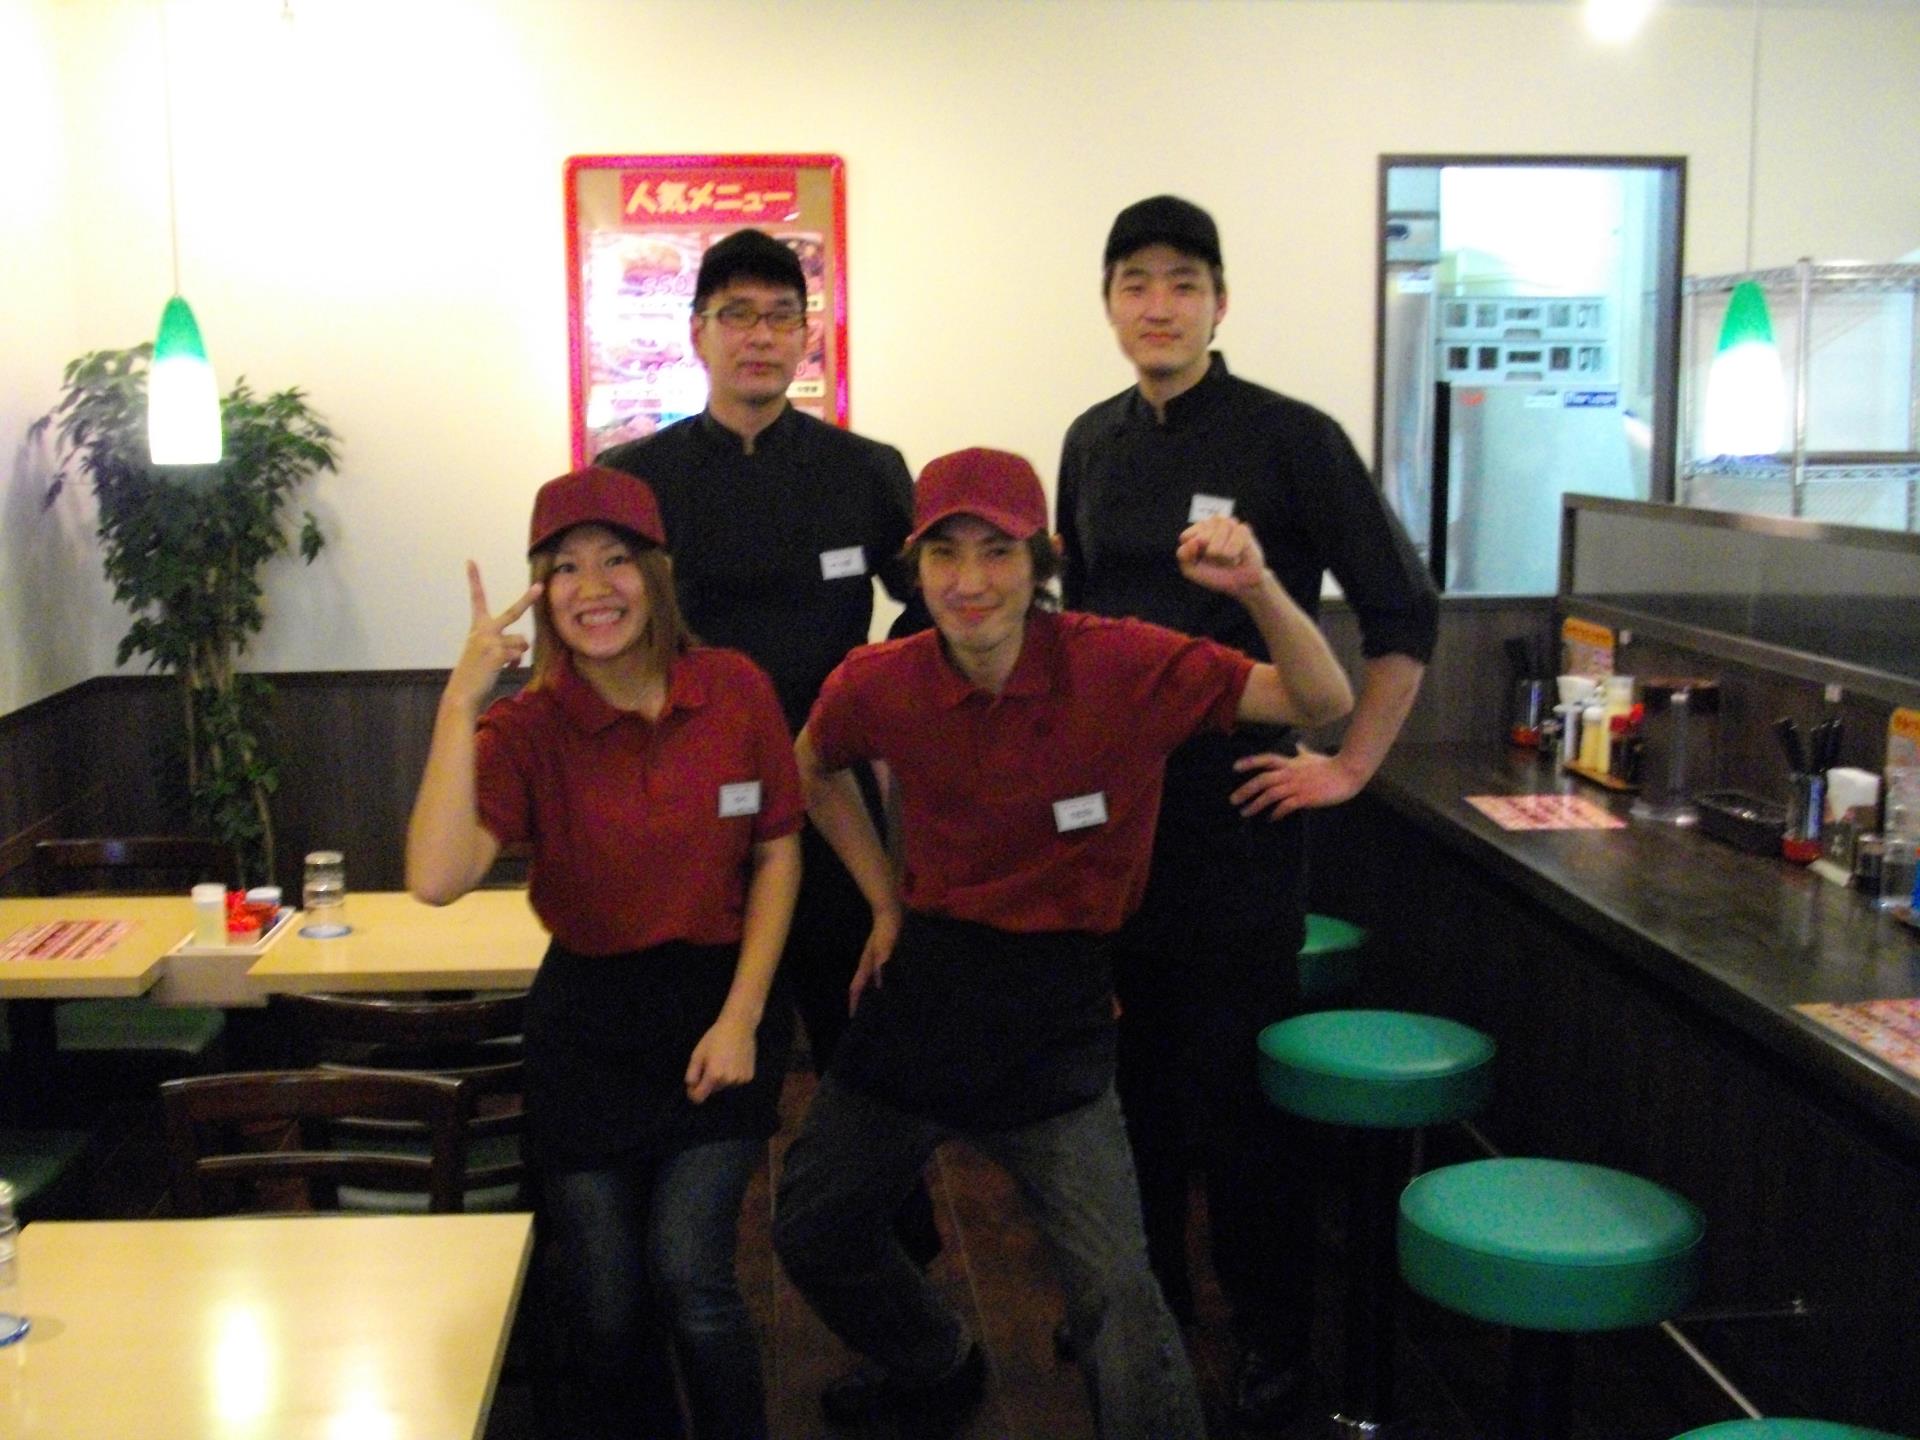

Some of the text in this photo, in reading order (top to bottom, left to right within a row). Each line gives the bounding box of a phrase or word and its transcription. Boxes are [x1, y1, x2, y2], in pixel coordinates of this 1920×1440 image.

[625, 181, 793, 214] 人気メニュー
